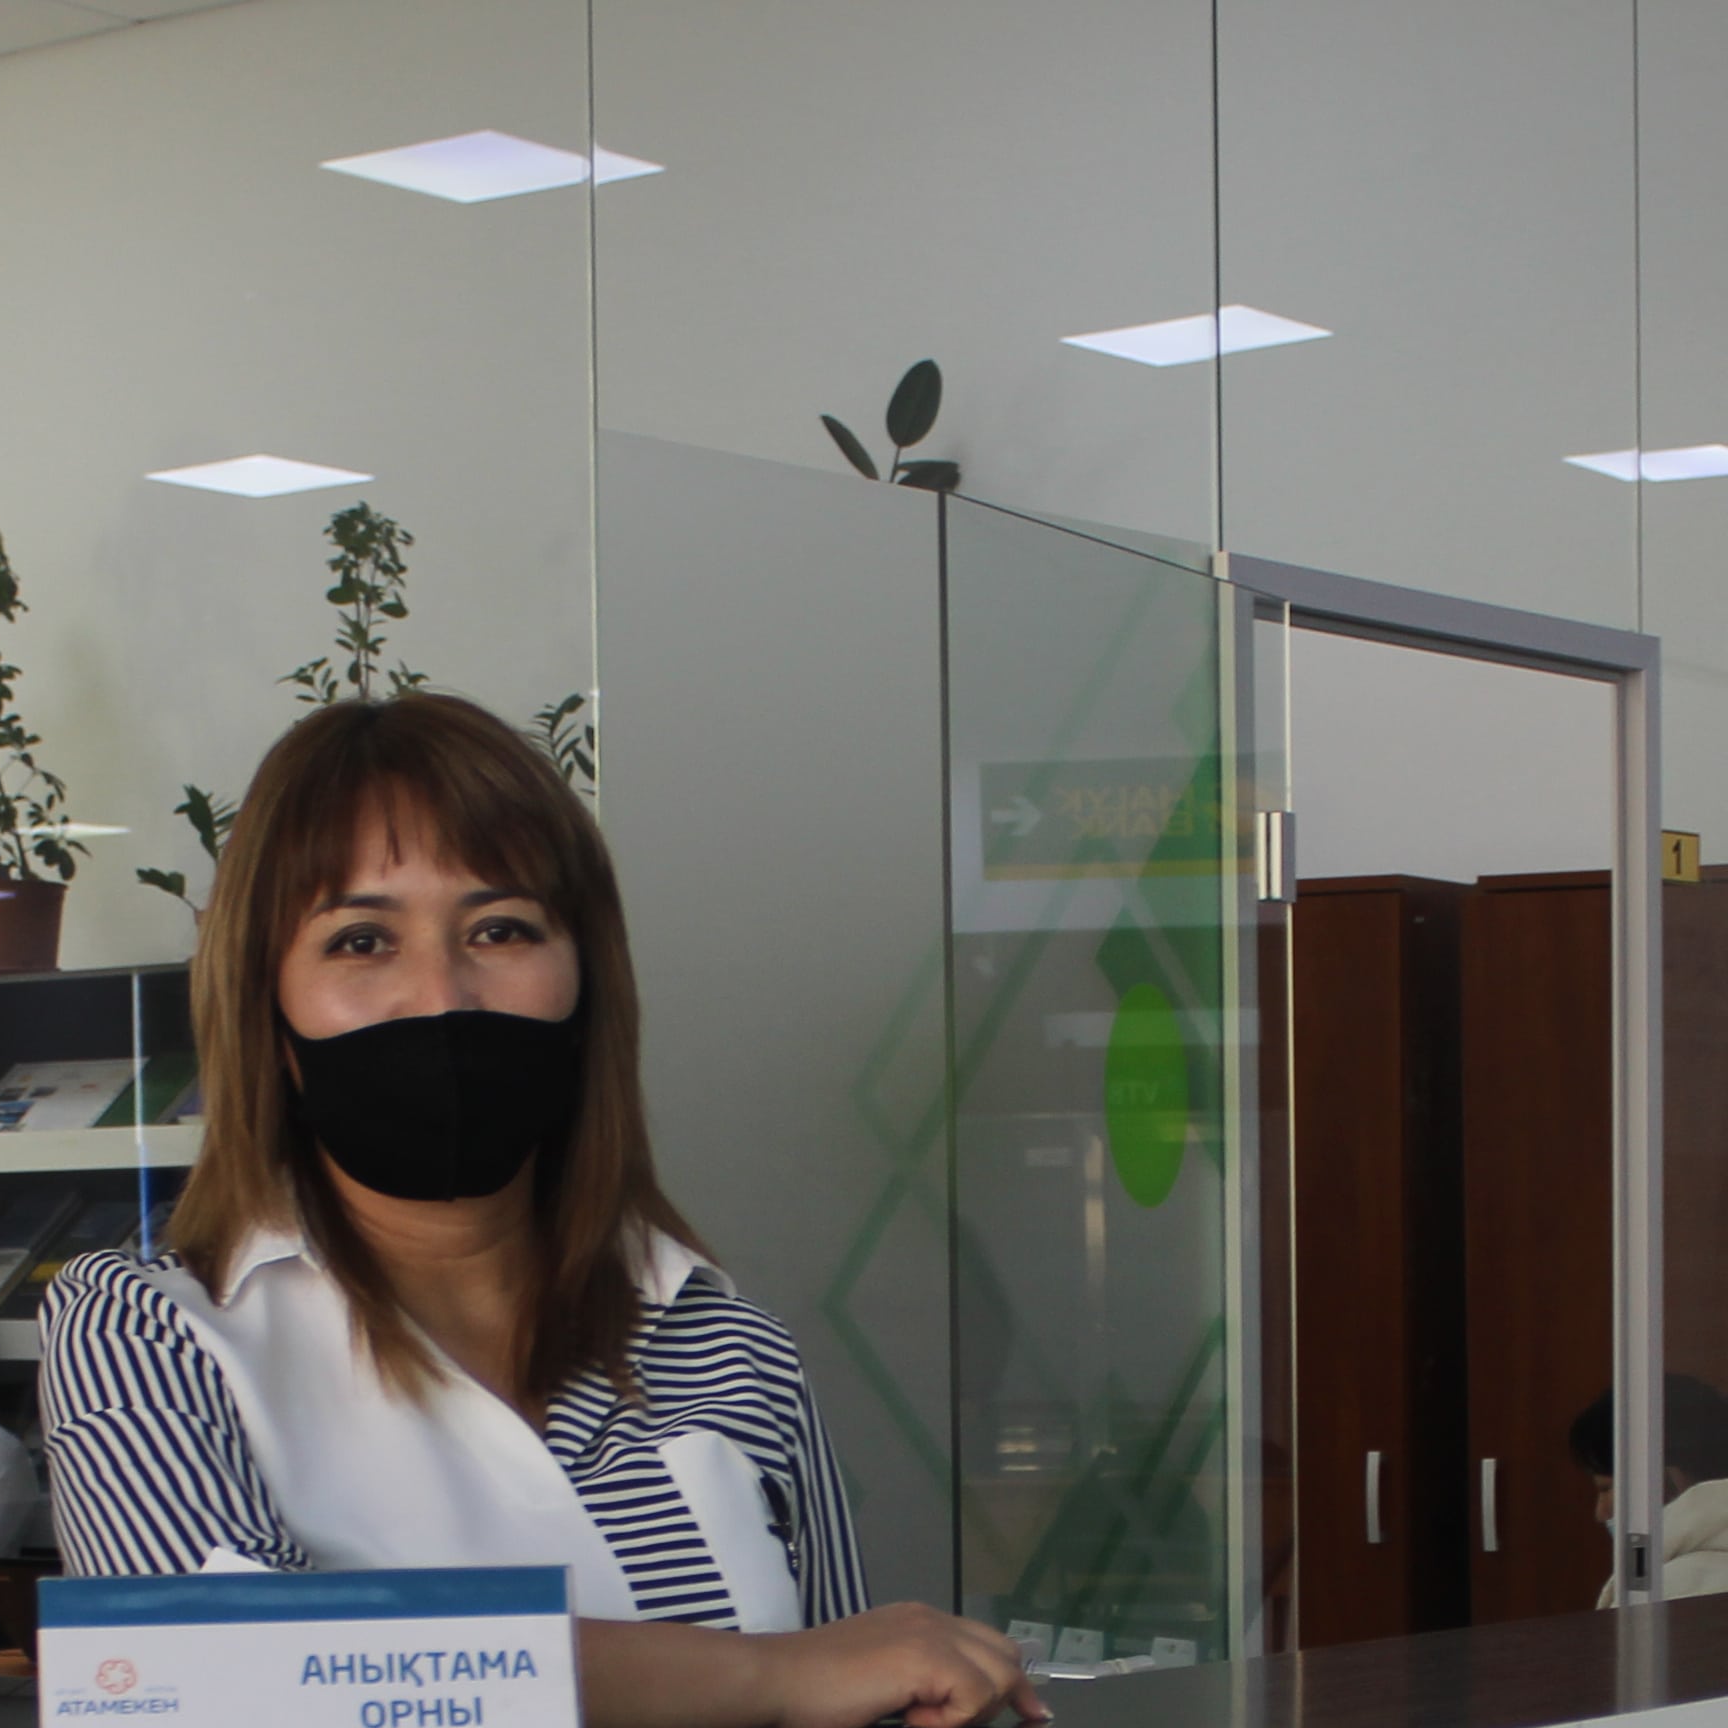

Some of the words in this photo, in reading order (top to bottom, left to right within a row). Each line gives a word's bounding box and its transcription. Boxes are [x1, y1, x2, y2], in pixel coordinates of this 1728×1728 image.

[1672, 838, 1682, 876] 1
[300, 1649, 537, 1687] АНЫҚТАМА
[56, 1698, 179, 1716] АТАМЕКЕН
